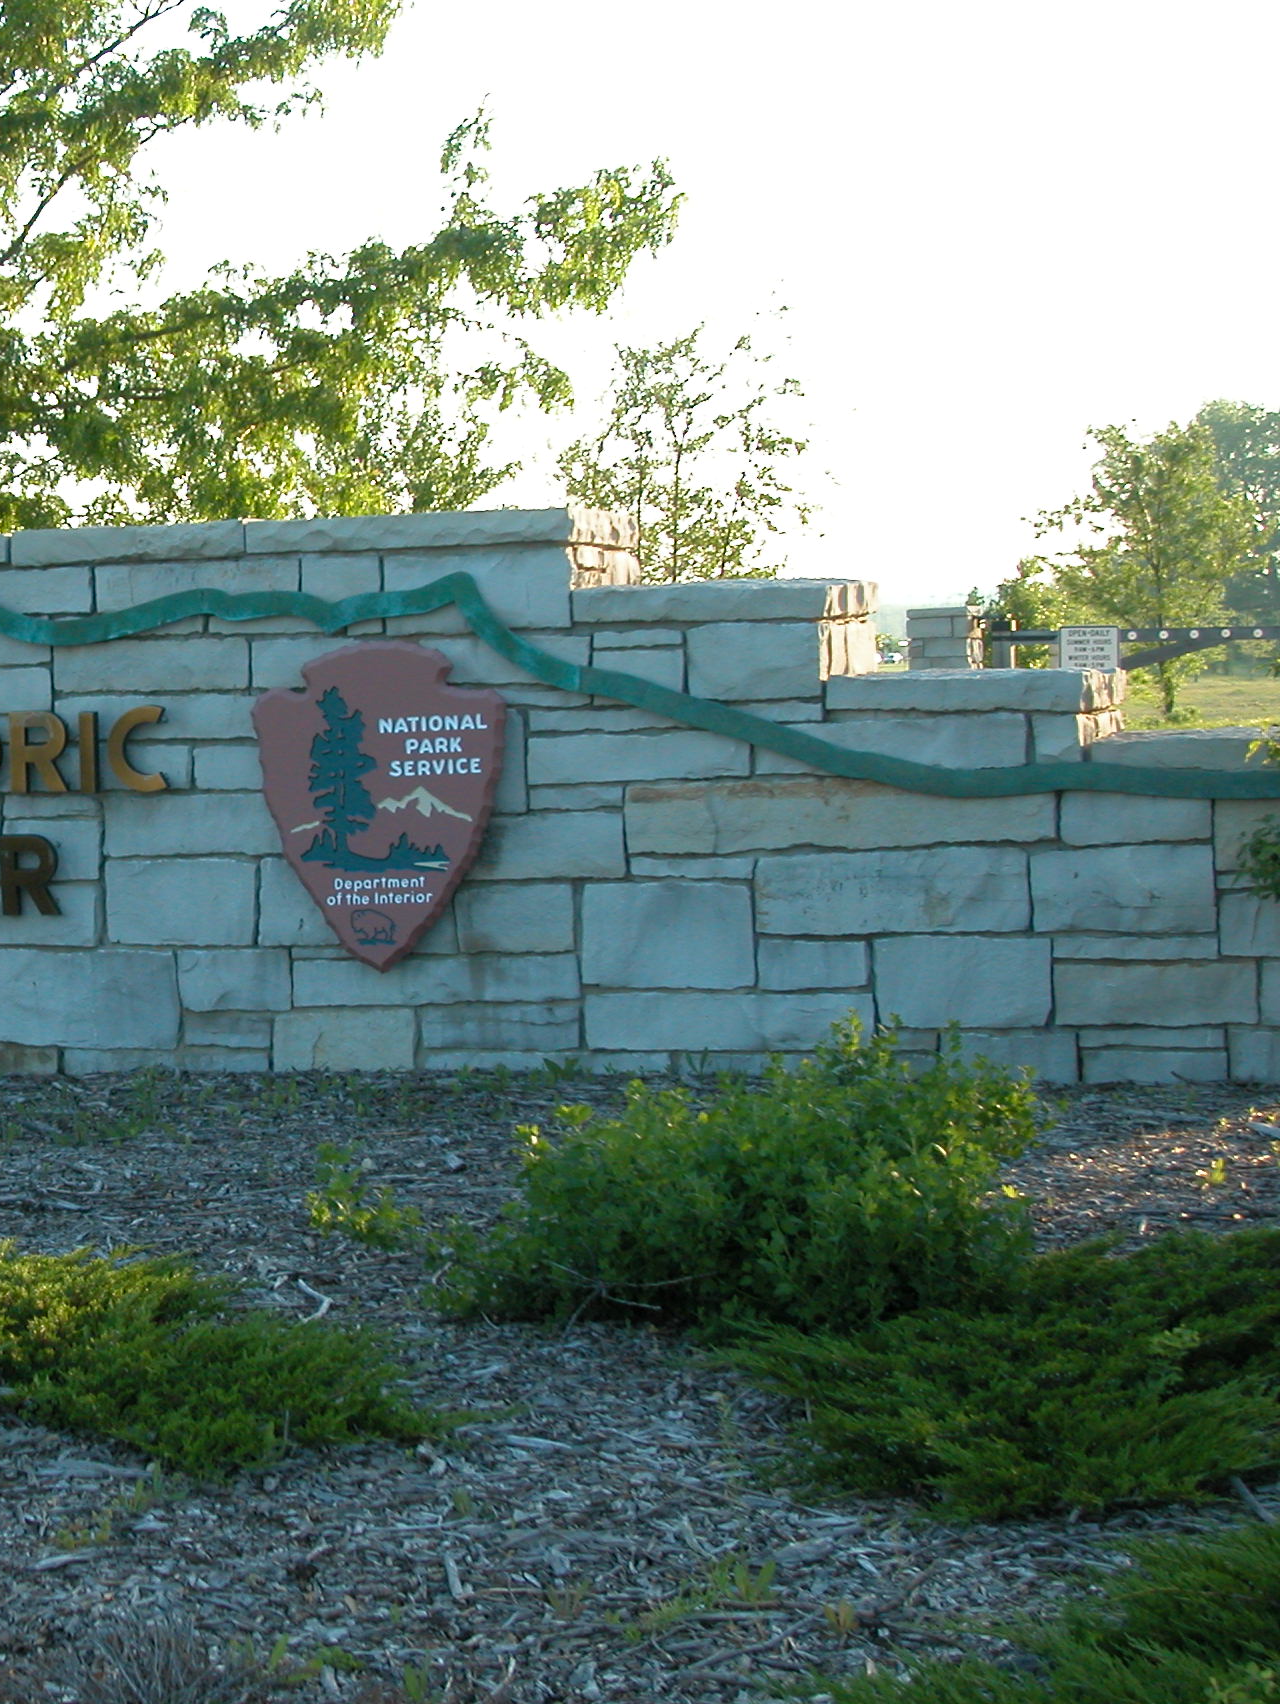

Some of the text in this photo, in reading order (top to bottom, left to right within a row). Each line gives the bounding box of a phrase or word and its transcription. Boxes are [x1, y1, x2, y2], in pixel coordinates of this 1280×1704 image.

[377, 713, 488, 734] NATIONAL
[404, 736, 462, 754] PARK
[388, 757, 482, 777] SERVICE
[333, 876, 426, 892] Department
[326, 889, 434, 906] of the Interior
